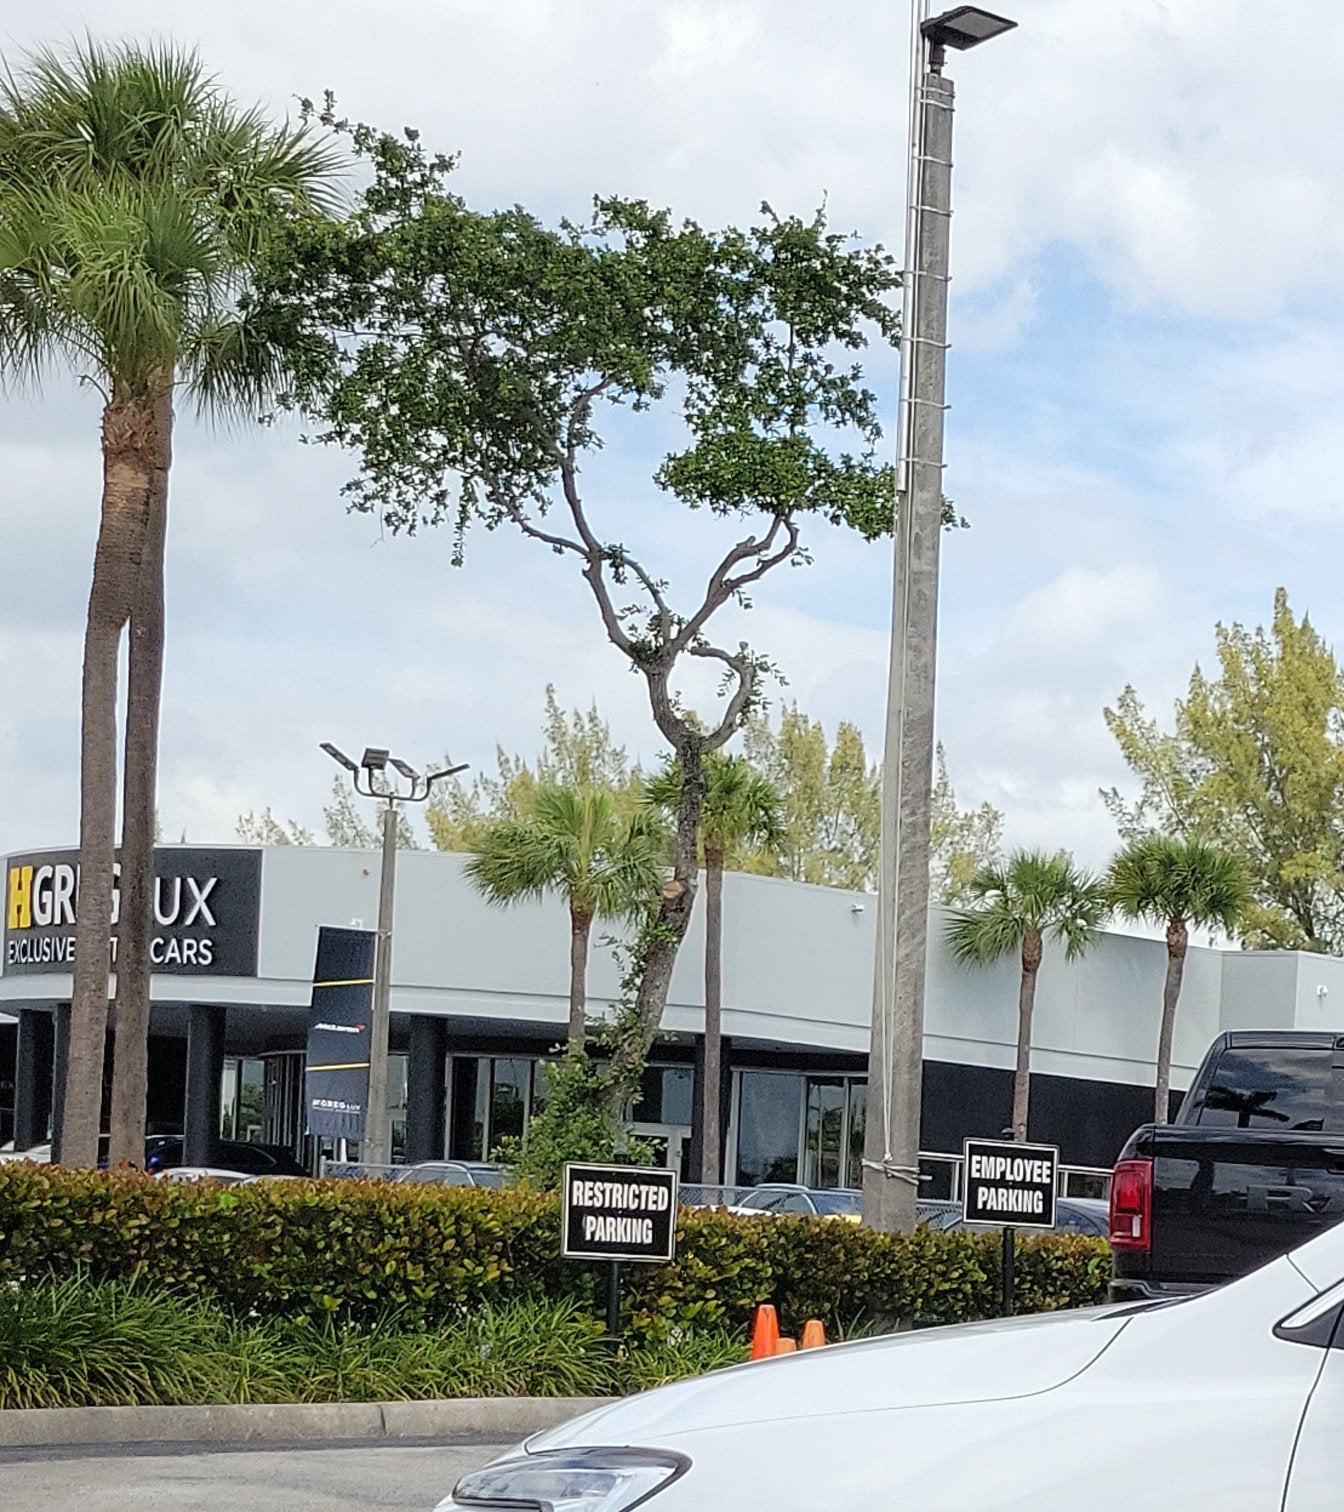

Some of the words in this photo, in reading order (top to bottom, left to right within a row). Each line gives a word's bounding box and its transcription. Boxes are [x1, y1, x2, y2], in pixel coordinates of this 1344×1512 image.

[153, 877, 217, 926] UX
[8, 936, 76, 964] EXCLUSIVE
[150, 937, 213, 965] CARS
[971, 1154, 1052, 1184] EMPLOYEE
[572, 1180, 669, 1211] RESTRICTED
[977, 1186, 1043, 1214] PARKING
[584, 1215, 653, 1244] PARKING
